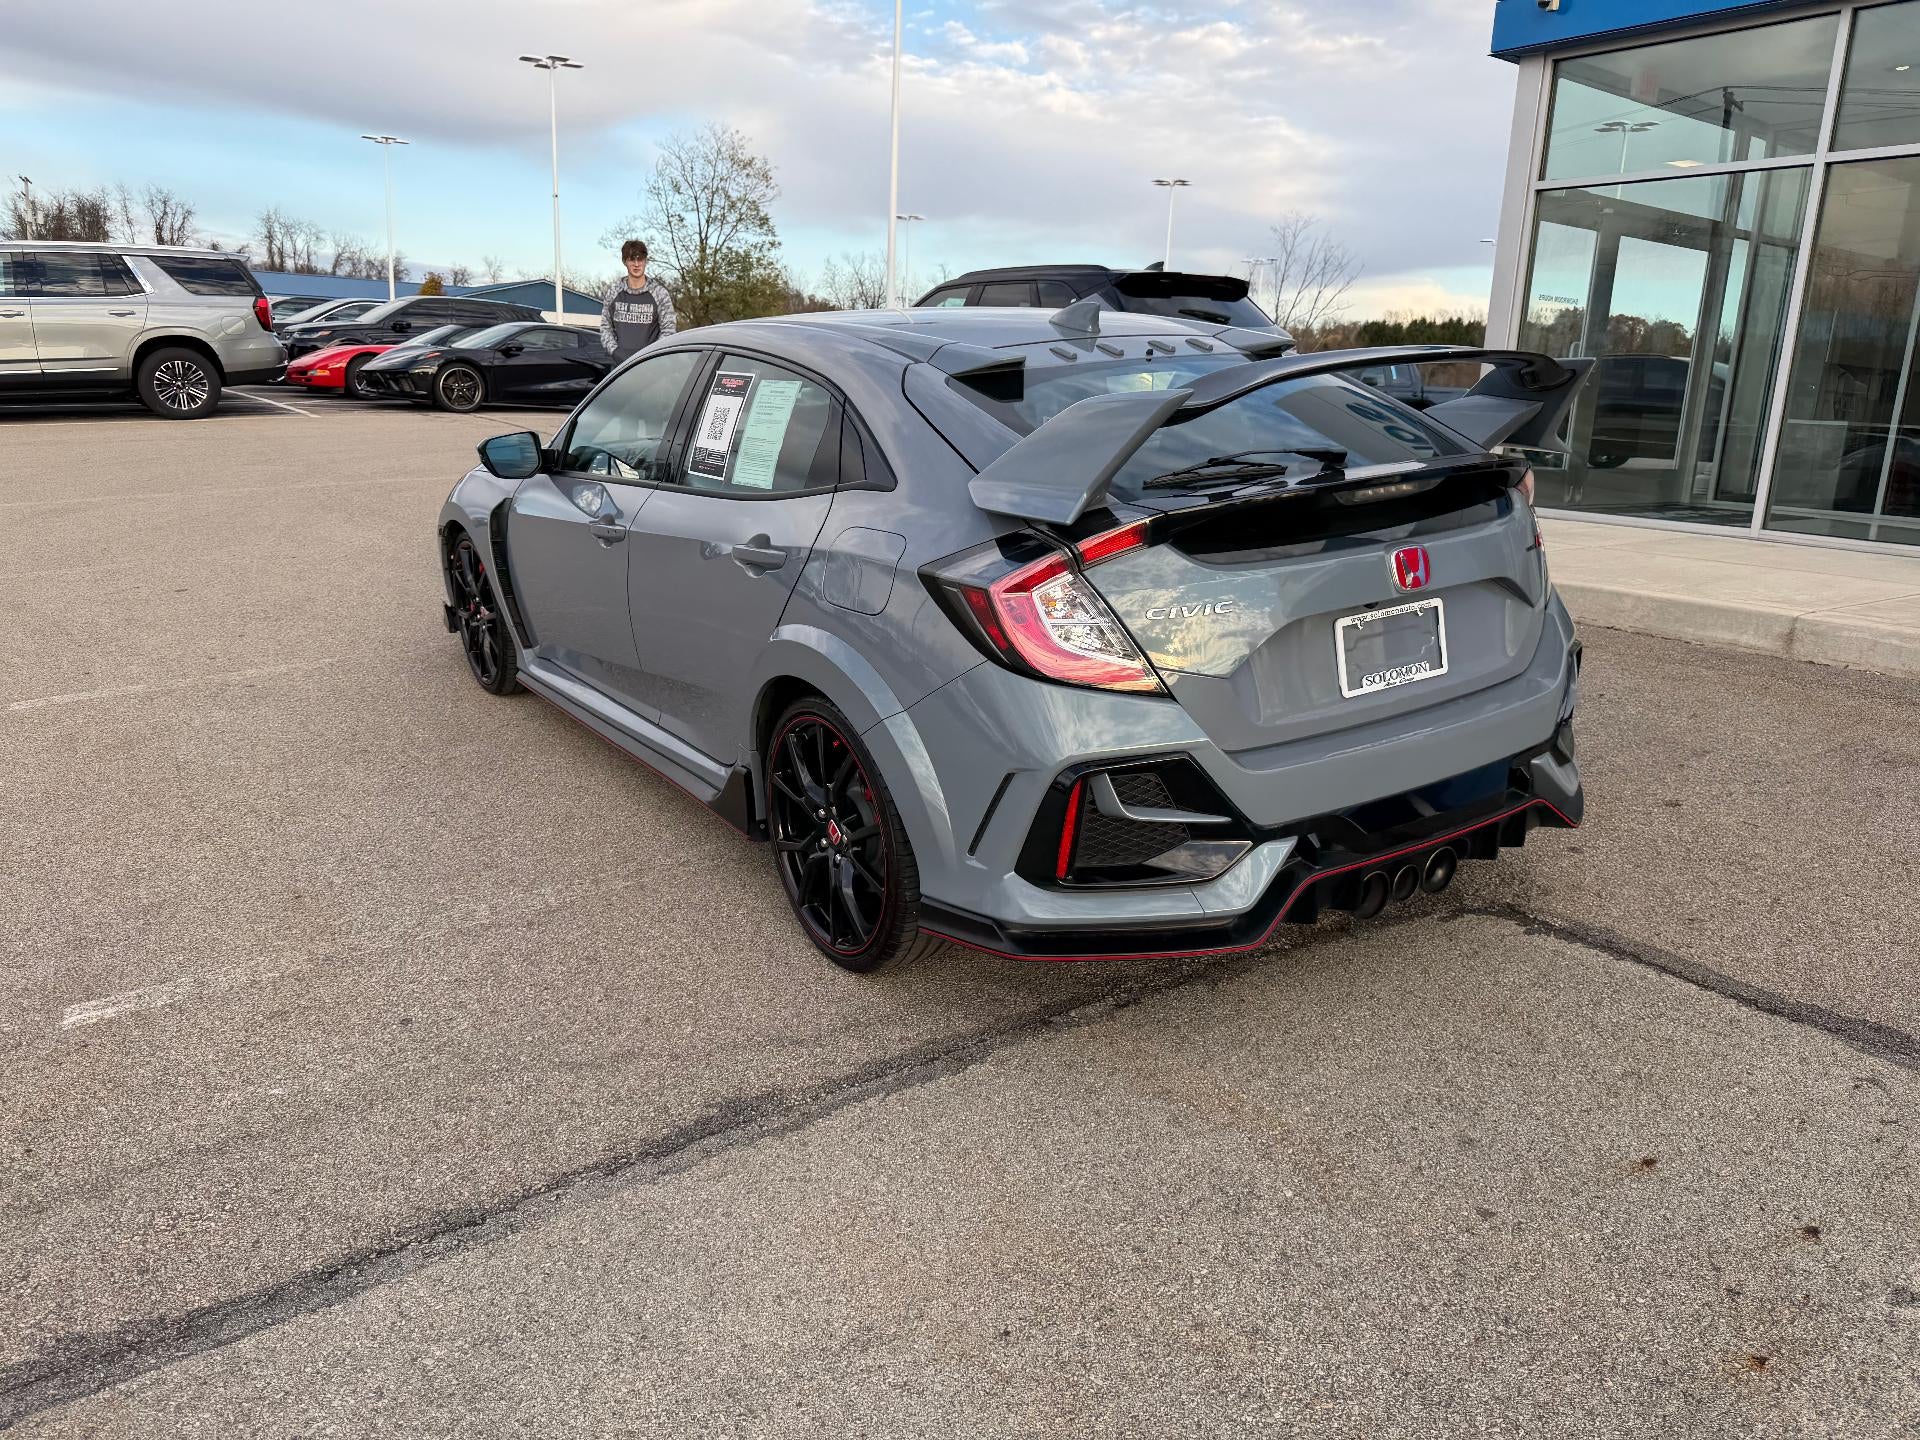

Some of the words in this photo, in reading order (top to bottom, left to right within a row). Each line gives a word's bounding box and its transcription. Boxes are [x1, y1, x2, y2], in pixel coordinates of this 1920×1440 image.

[629, 303, 654, 314] VIRGINIA
[1145, 600, 1233, 621] CIVIC
[1350, 601, 1432, 624] www.solomonauto.com
[1365, 662, 1429, 687] SOLOMON
